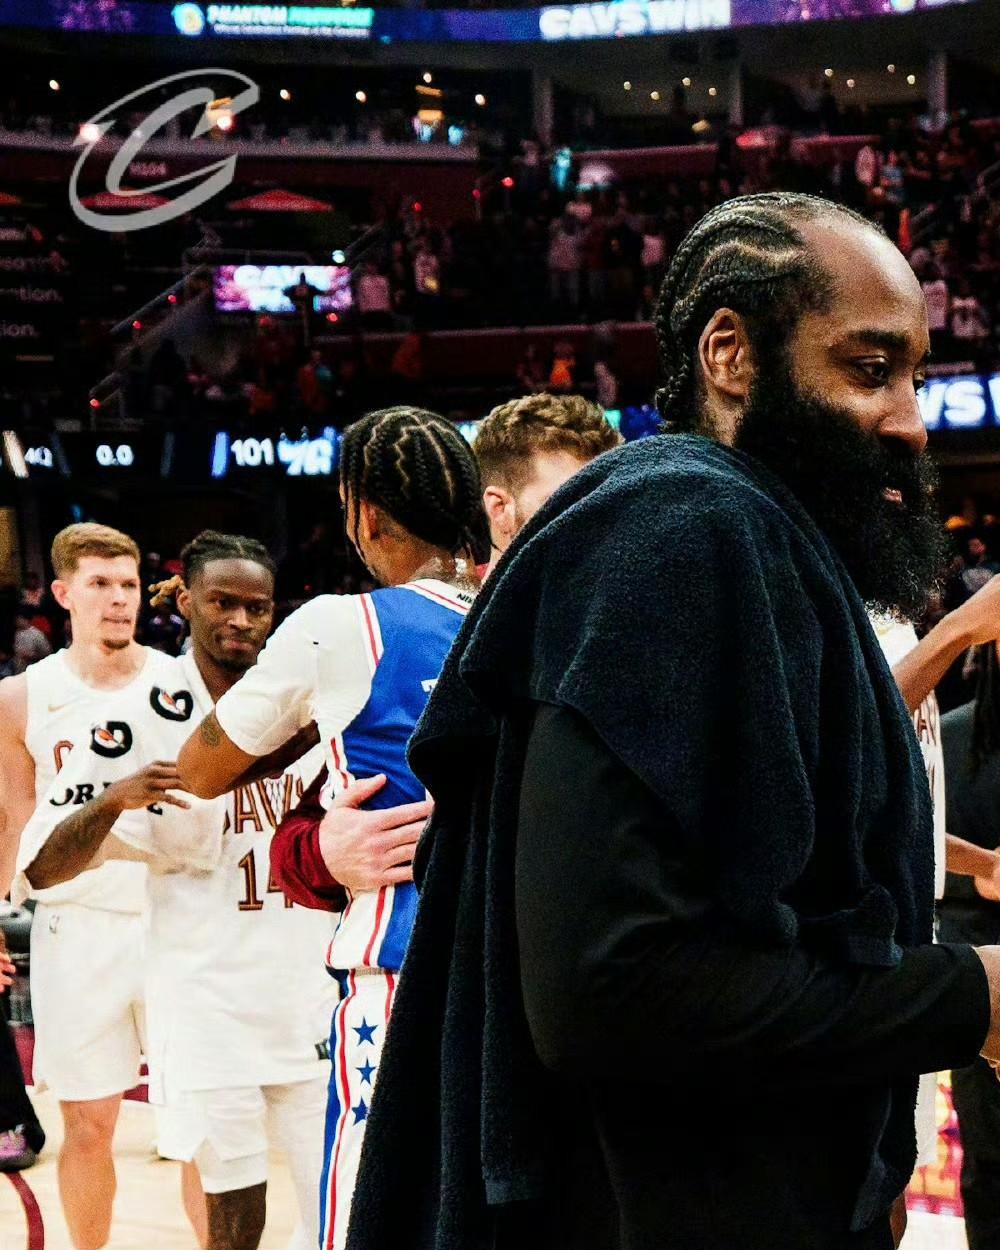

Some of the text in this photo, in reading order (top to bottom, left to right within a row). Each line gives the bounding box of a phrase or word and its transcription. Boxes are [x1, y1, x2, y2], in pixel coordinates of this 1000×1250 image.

[538, 4, 648, 41] CAVS
[916, 380, 986, 426] VS
[96, 444, 134, 466] 0.0
[230, 438, 275, 467] 101
